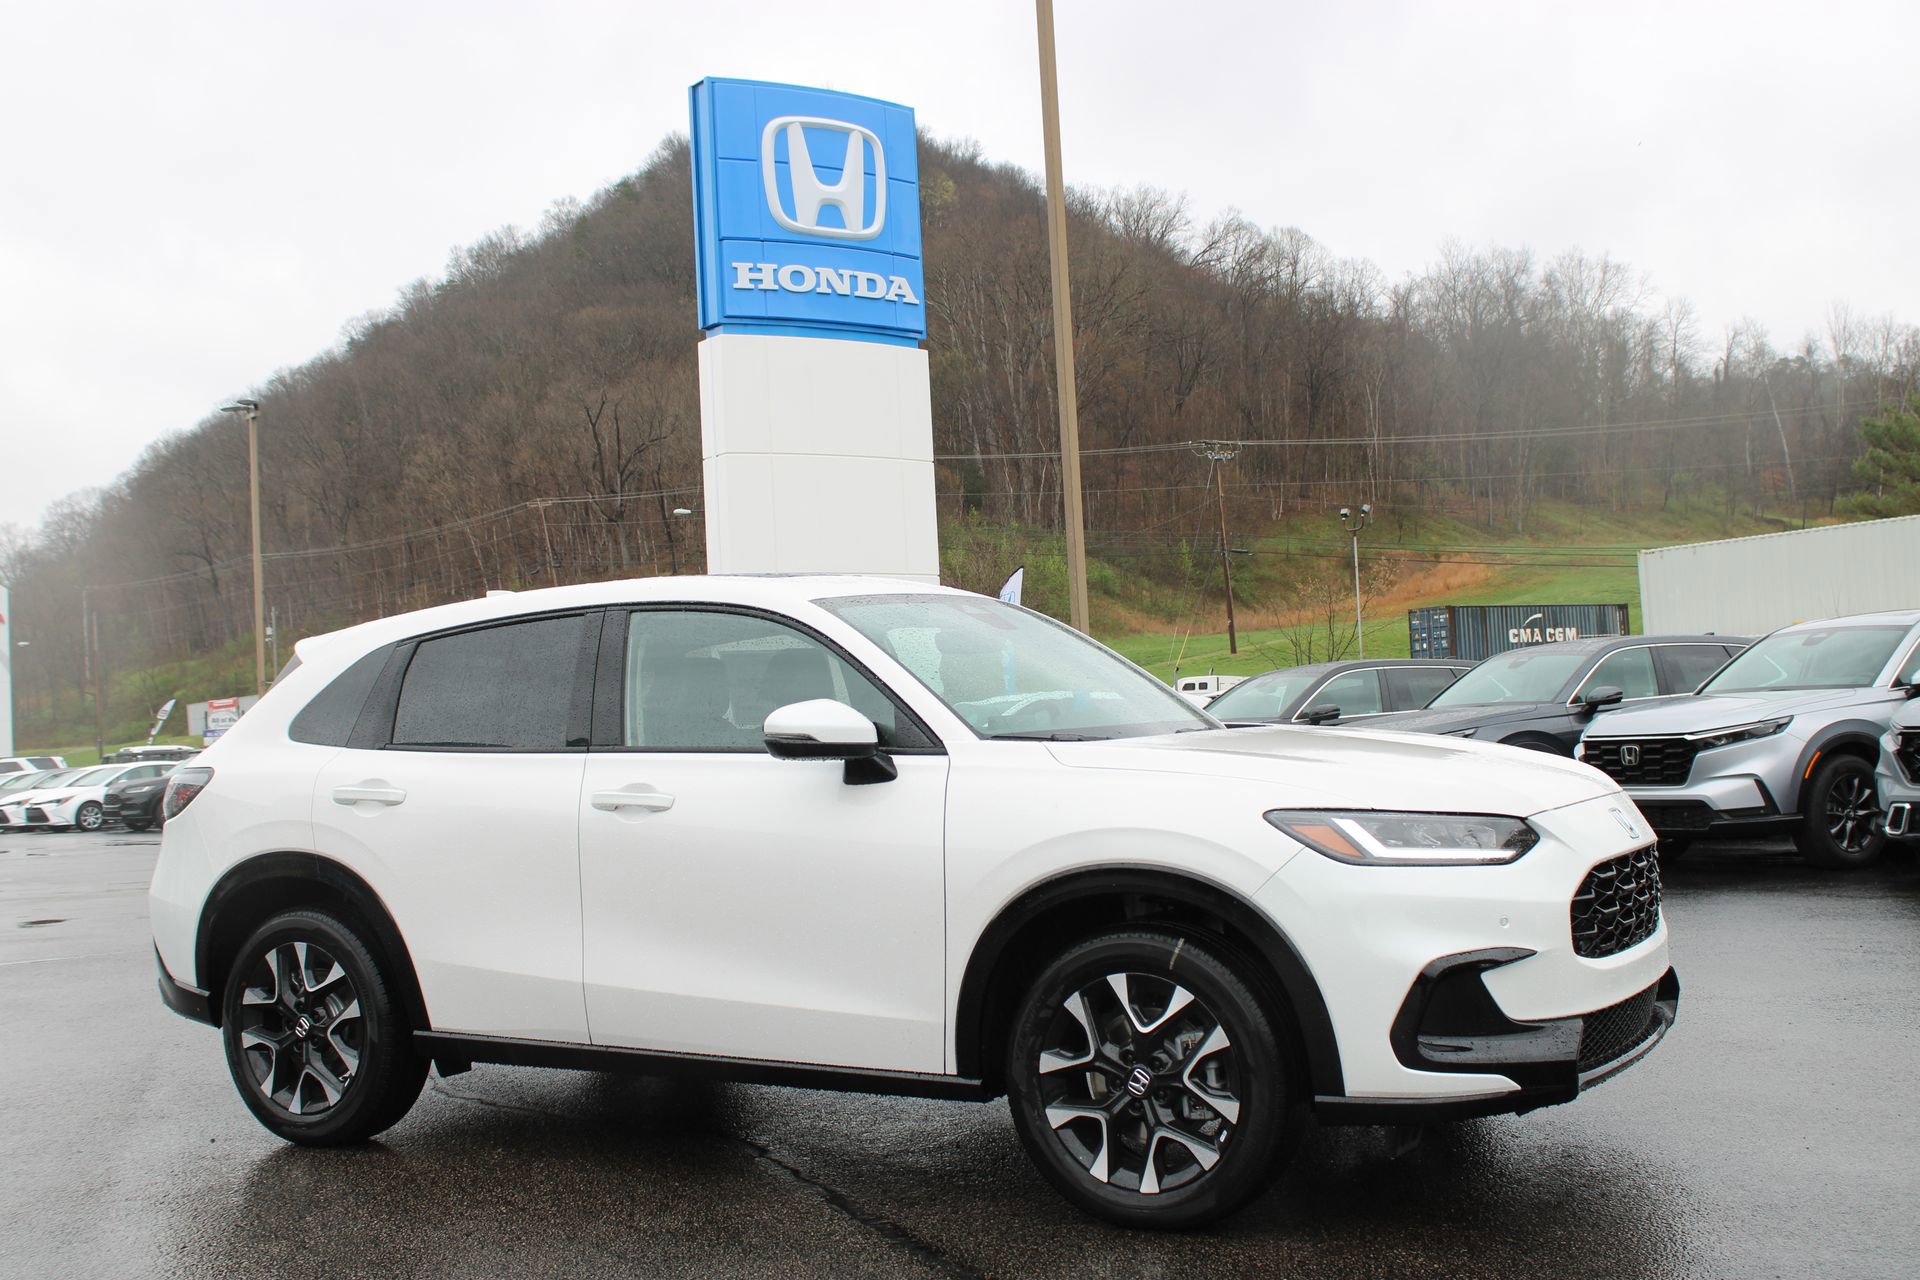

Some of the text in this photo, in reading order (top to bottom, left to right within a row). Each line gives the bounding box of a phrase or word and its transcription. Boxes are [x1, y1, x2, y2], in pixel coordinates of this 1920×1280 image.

[731, 262, 920, 305] HONDA
[1509, 627, 1578, 643] CMA CGM
